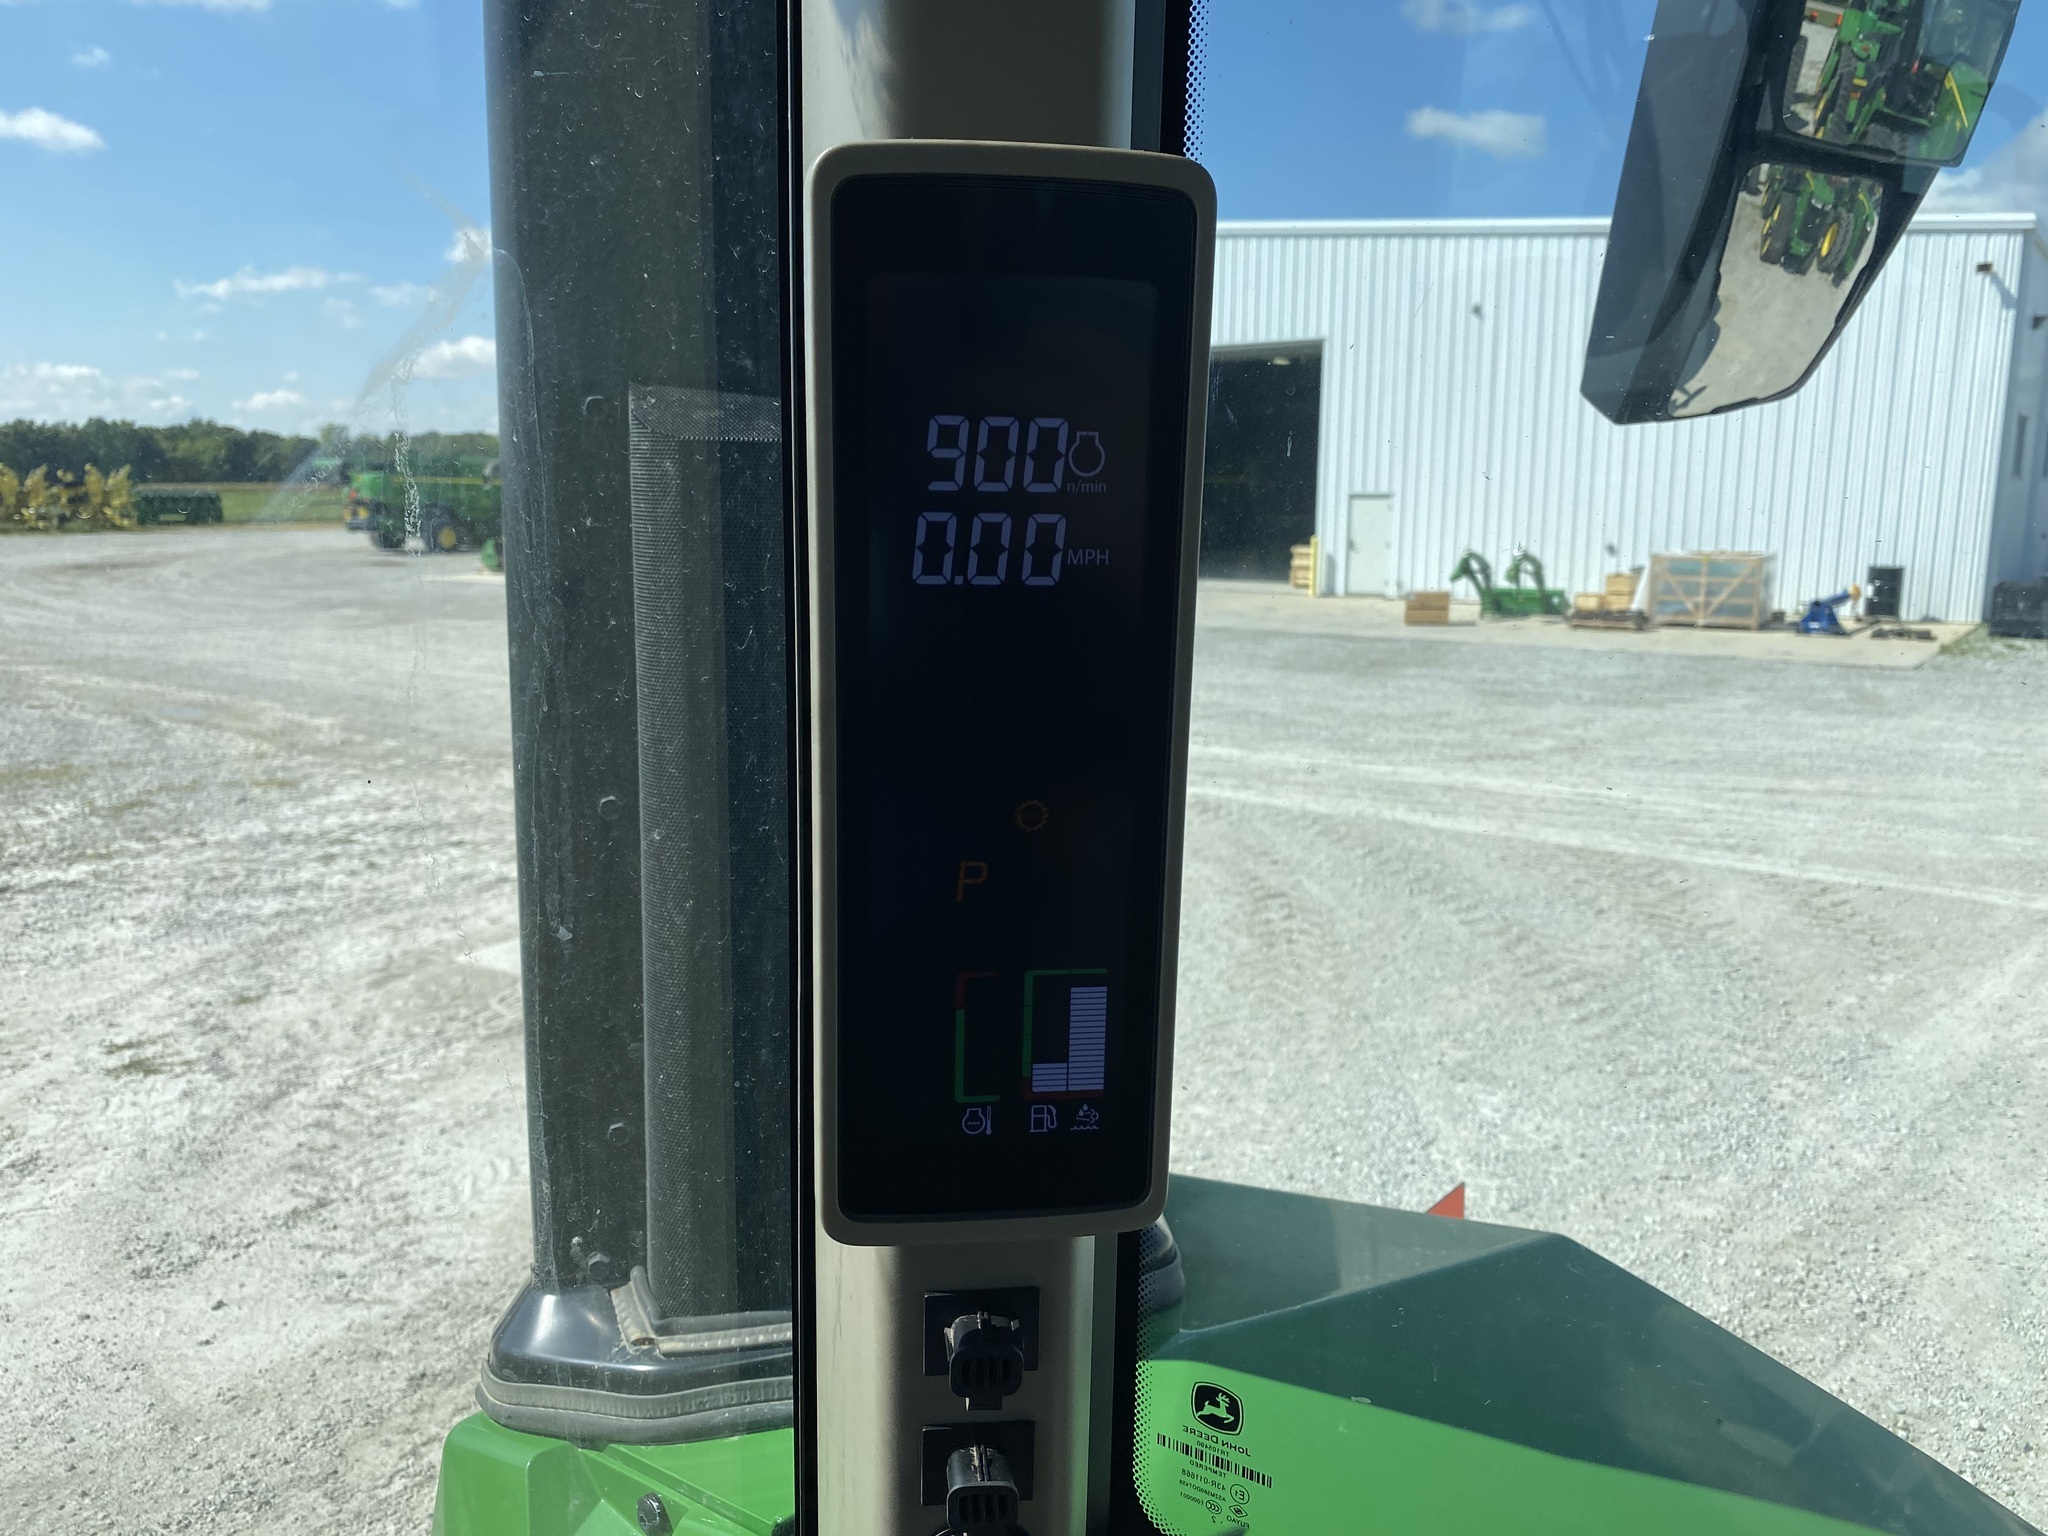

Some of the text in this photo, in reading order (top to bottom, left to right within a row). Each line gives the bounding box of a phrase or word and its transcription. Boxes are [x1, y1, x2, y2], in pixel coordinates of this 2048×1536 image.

[927, 415, 1107, 493] 900 n/min
[912, 511, 1109, 586] 0.00 MPH
[955, 860, 988, 902] P
